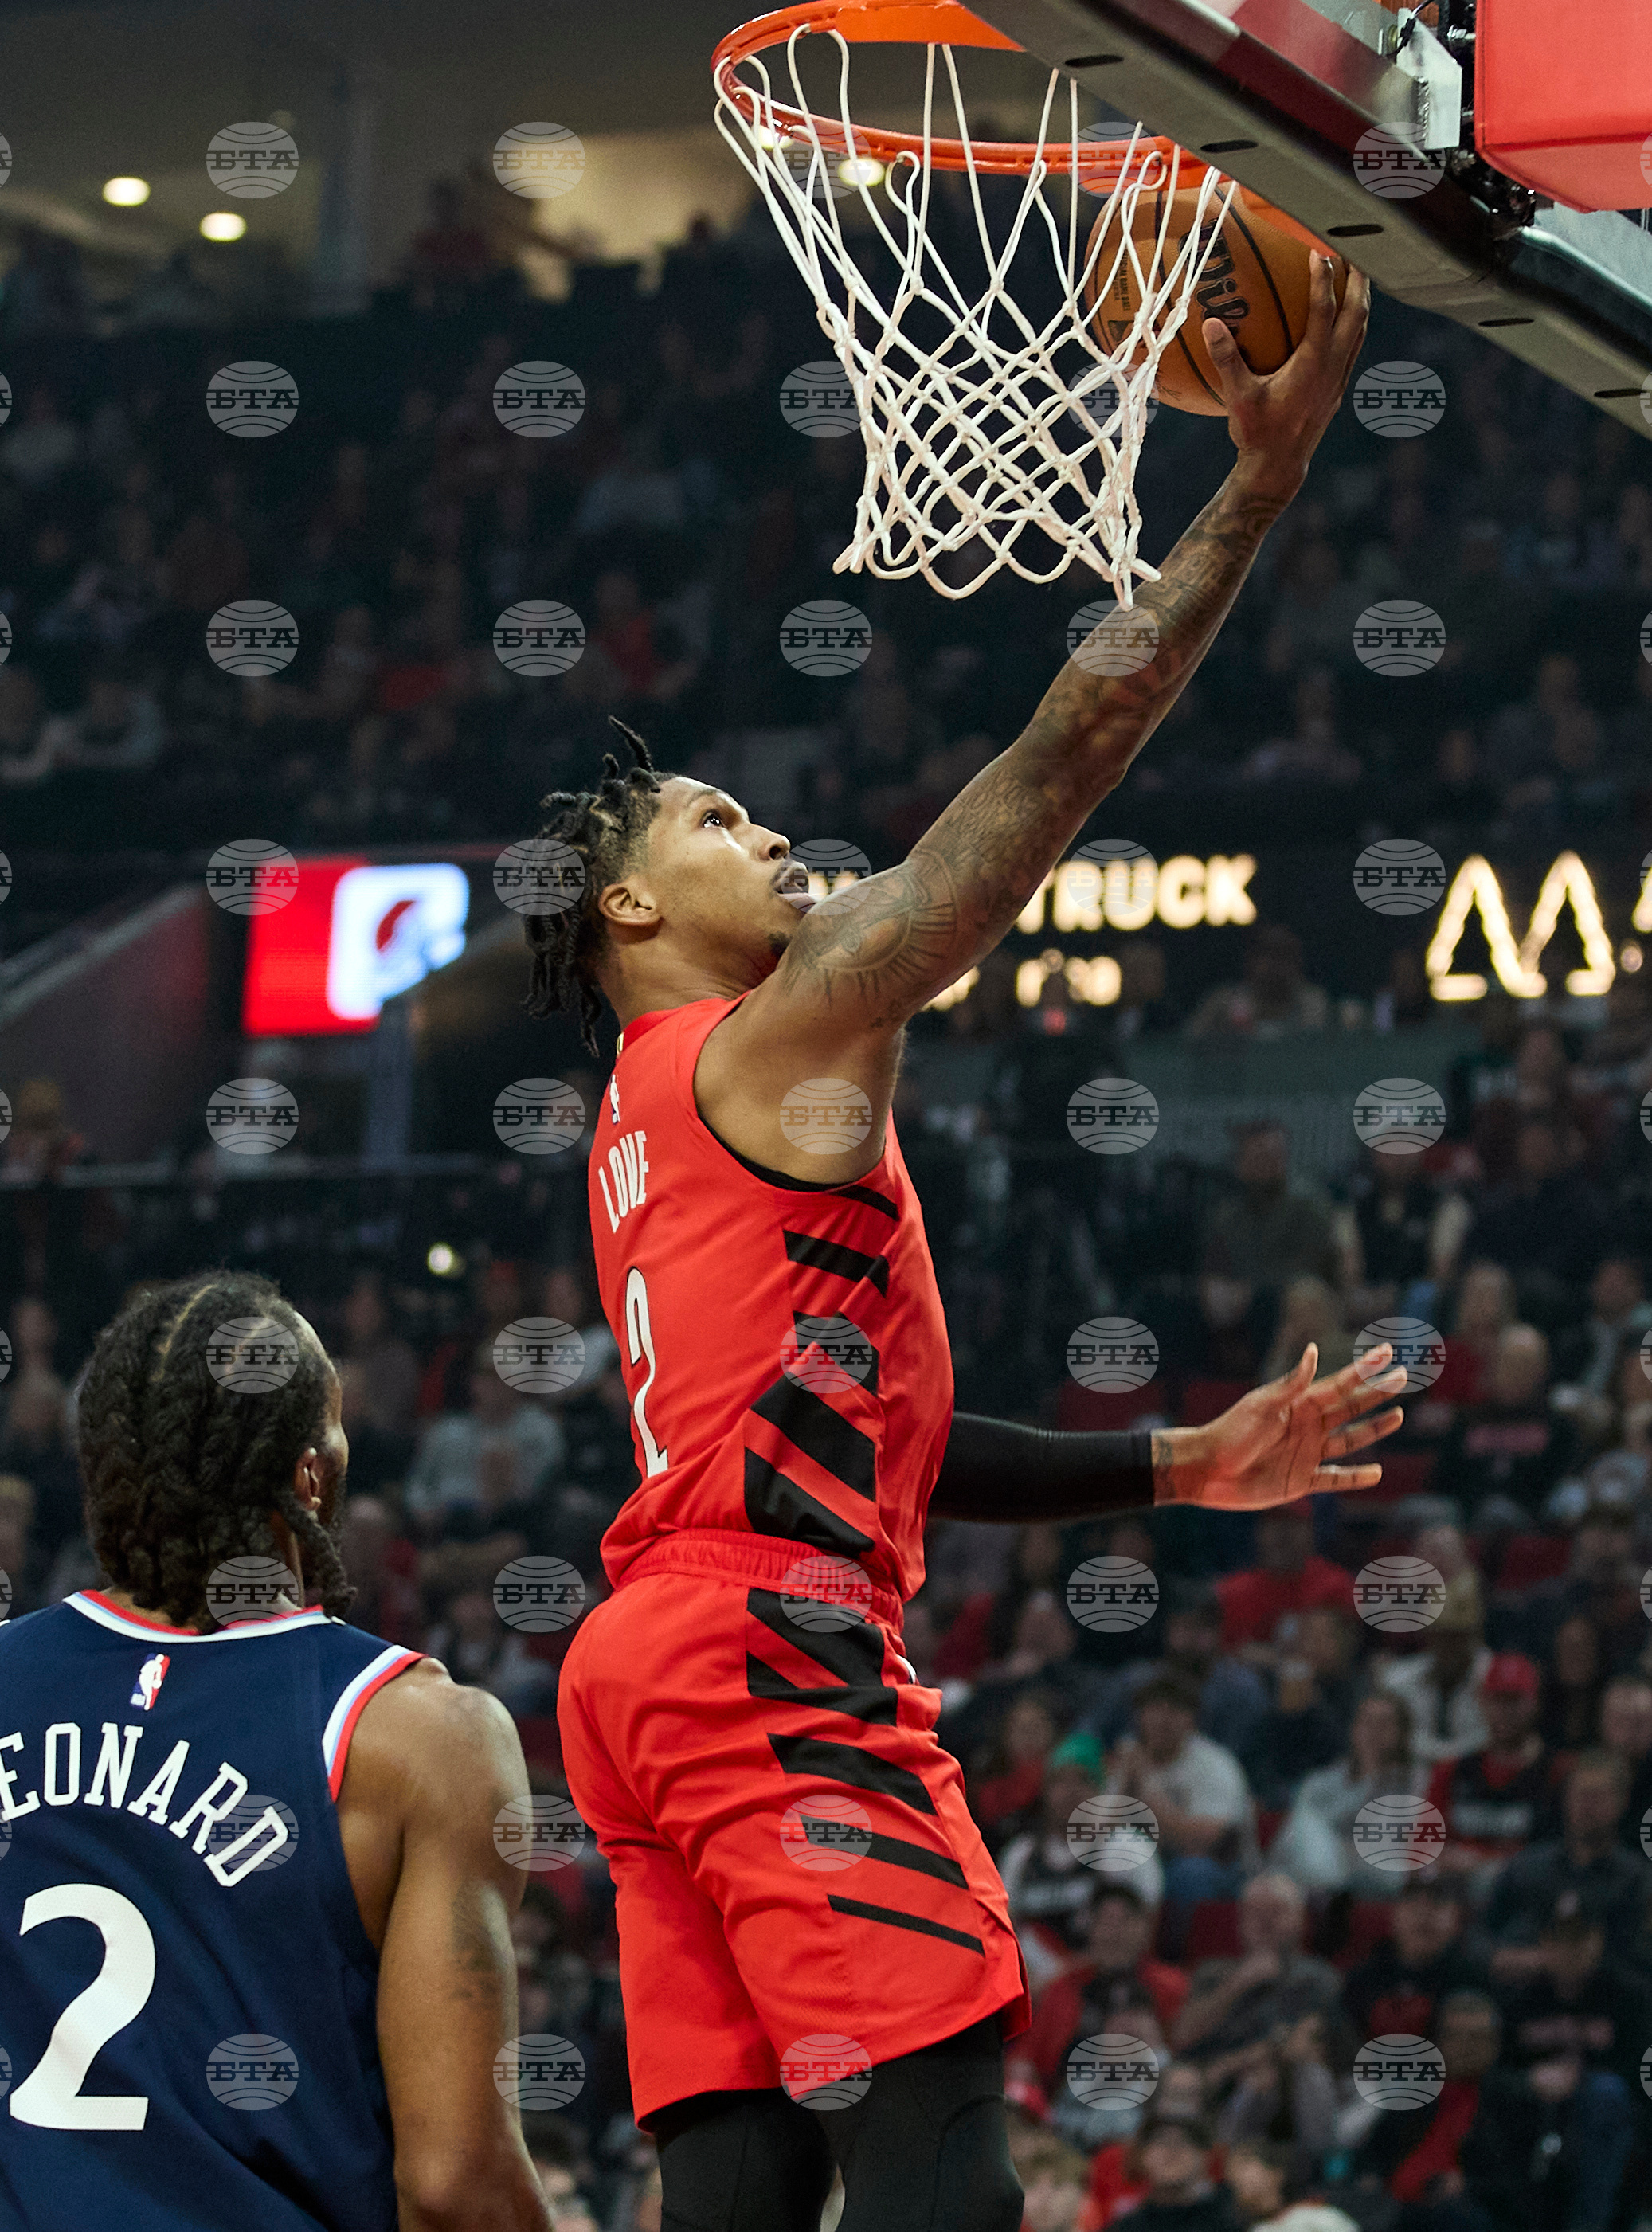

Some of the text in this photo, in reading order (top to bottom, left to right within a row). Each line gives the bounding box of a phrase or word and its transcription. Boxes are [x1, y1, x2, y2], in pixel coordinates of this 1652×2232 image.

[598, 1130, 649, 1234] LOVE
[625, 1266, 668, 1478] 2
[0, 1721, 288, 1887] EONARD
[10, 1883, 156, 2131] 2
